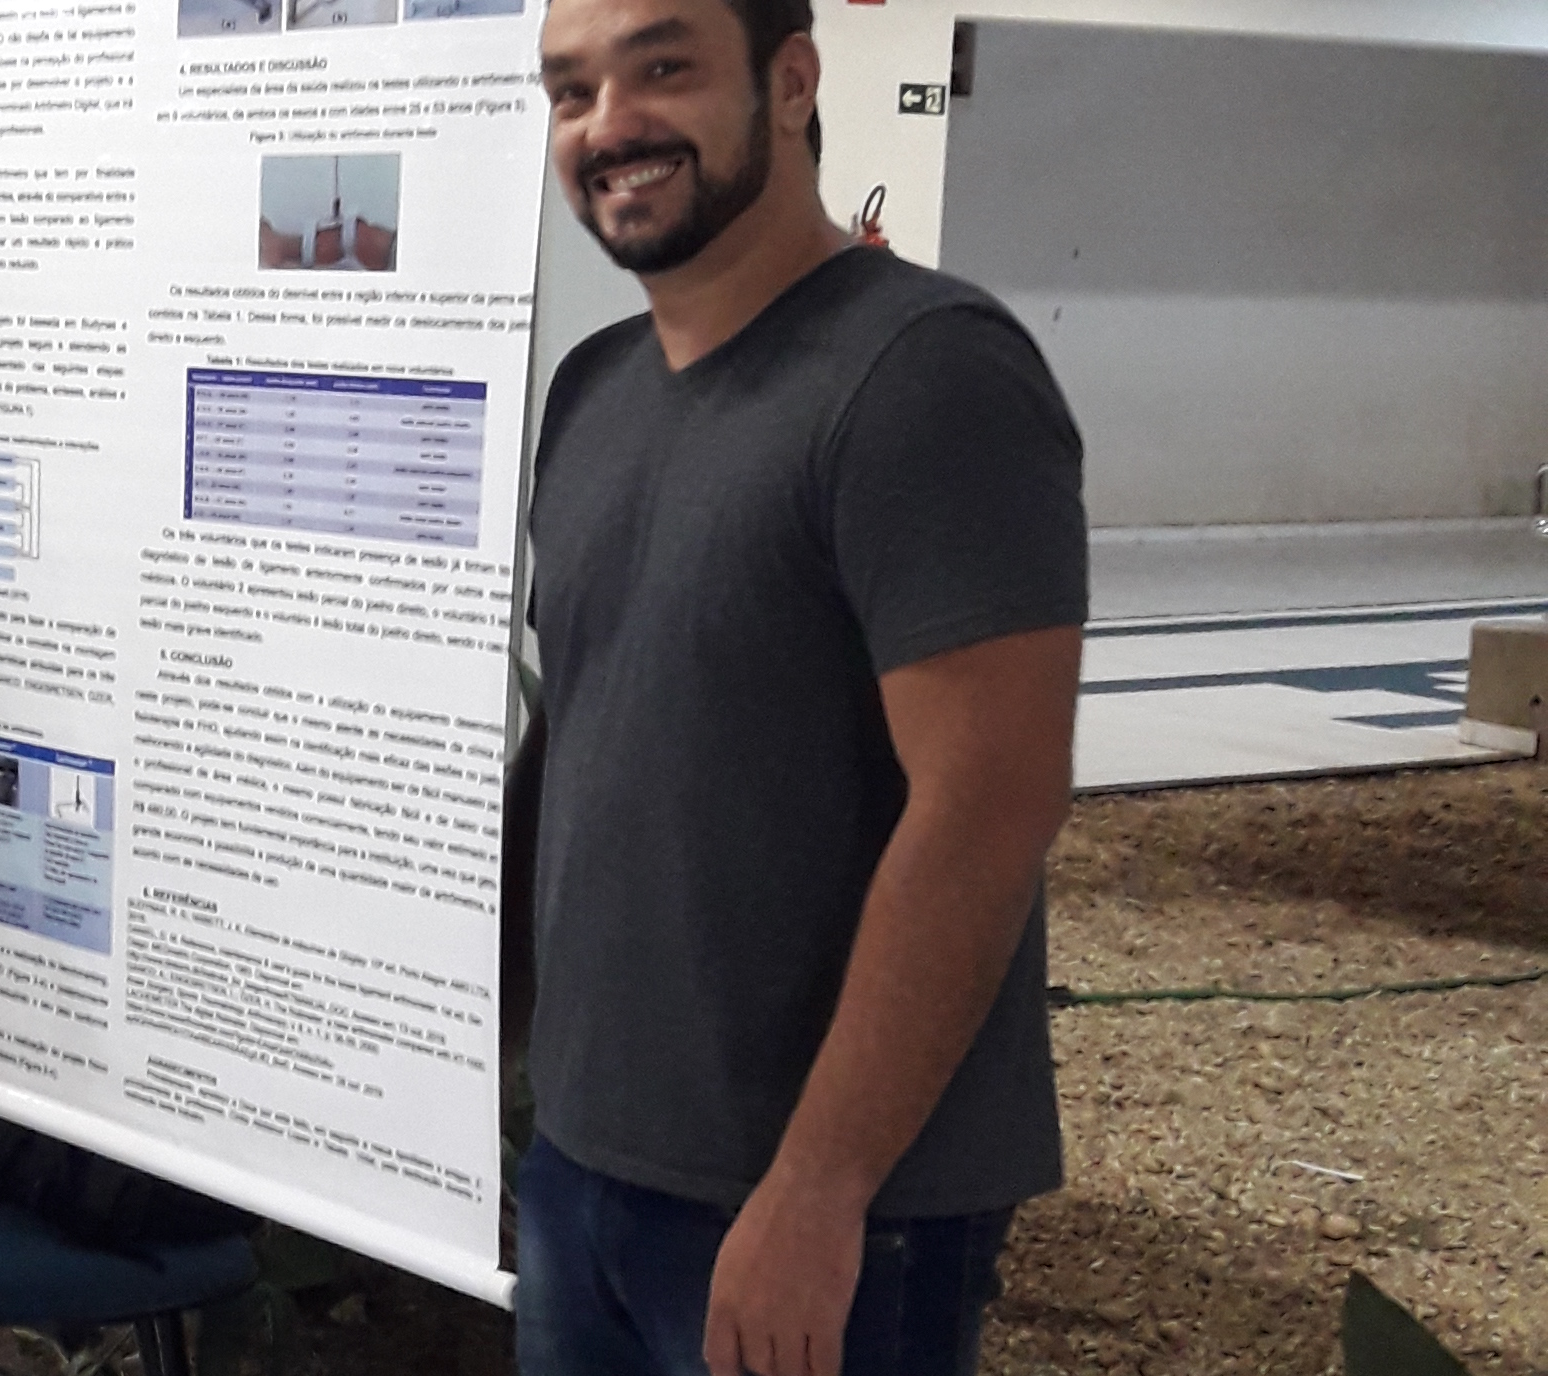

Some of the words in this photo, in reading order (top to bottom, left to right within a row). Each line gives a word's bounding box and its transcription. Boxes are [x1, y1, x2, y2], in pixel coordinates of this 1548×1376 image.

[179, 64, 187, 77] 4.
[189, 60, 257, 76] RESULTADOS
[258, 59, 266, 73] E
[267, 55, 328, 73] DISCUSSÃO
